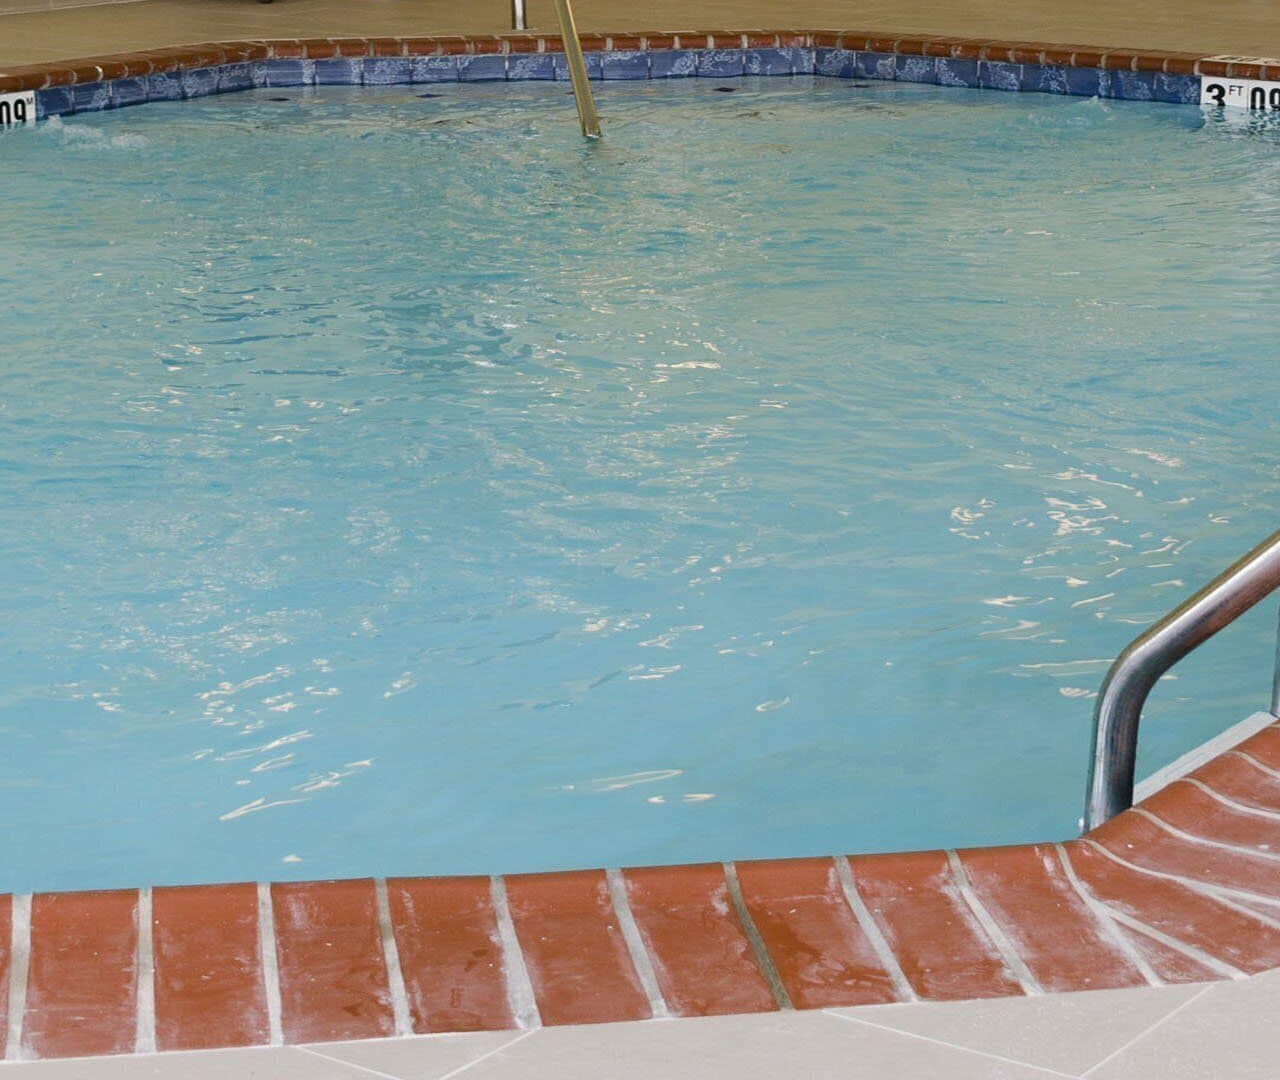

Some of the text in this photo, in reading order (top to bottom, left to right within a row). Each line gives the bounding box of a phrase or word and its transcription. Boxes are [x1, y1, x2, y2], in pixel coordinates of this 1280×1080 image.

[27, 97, 34, 106] M
[1205, 83, 1226, 107] 3
[1229, 85, 1244, 97] FT
